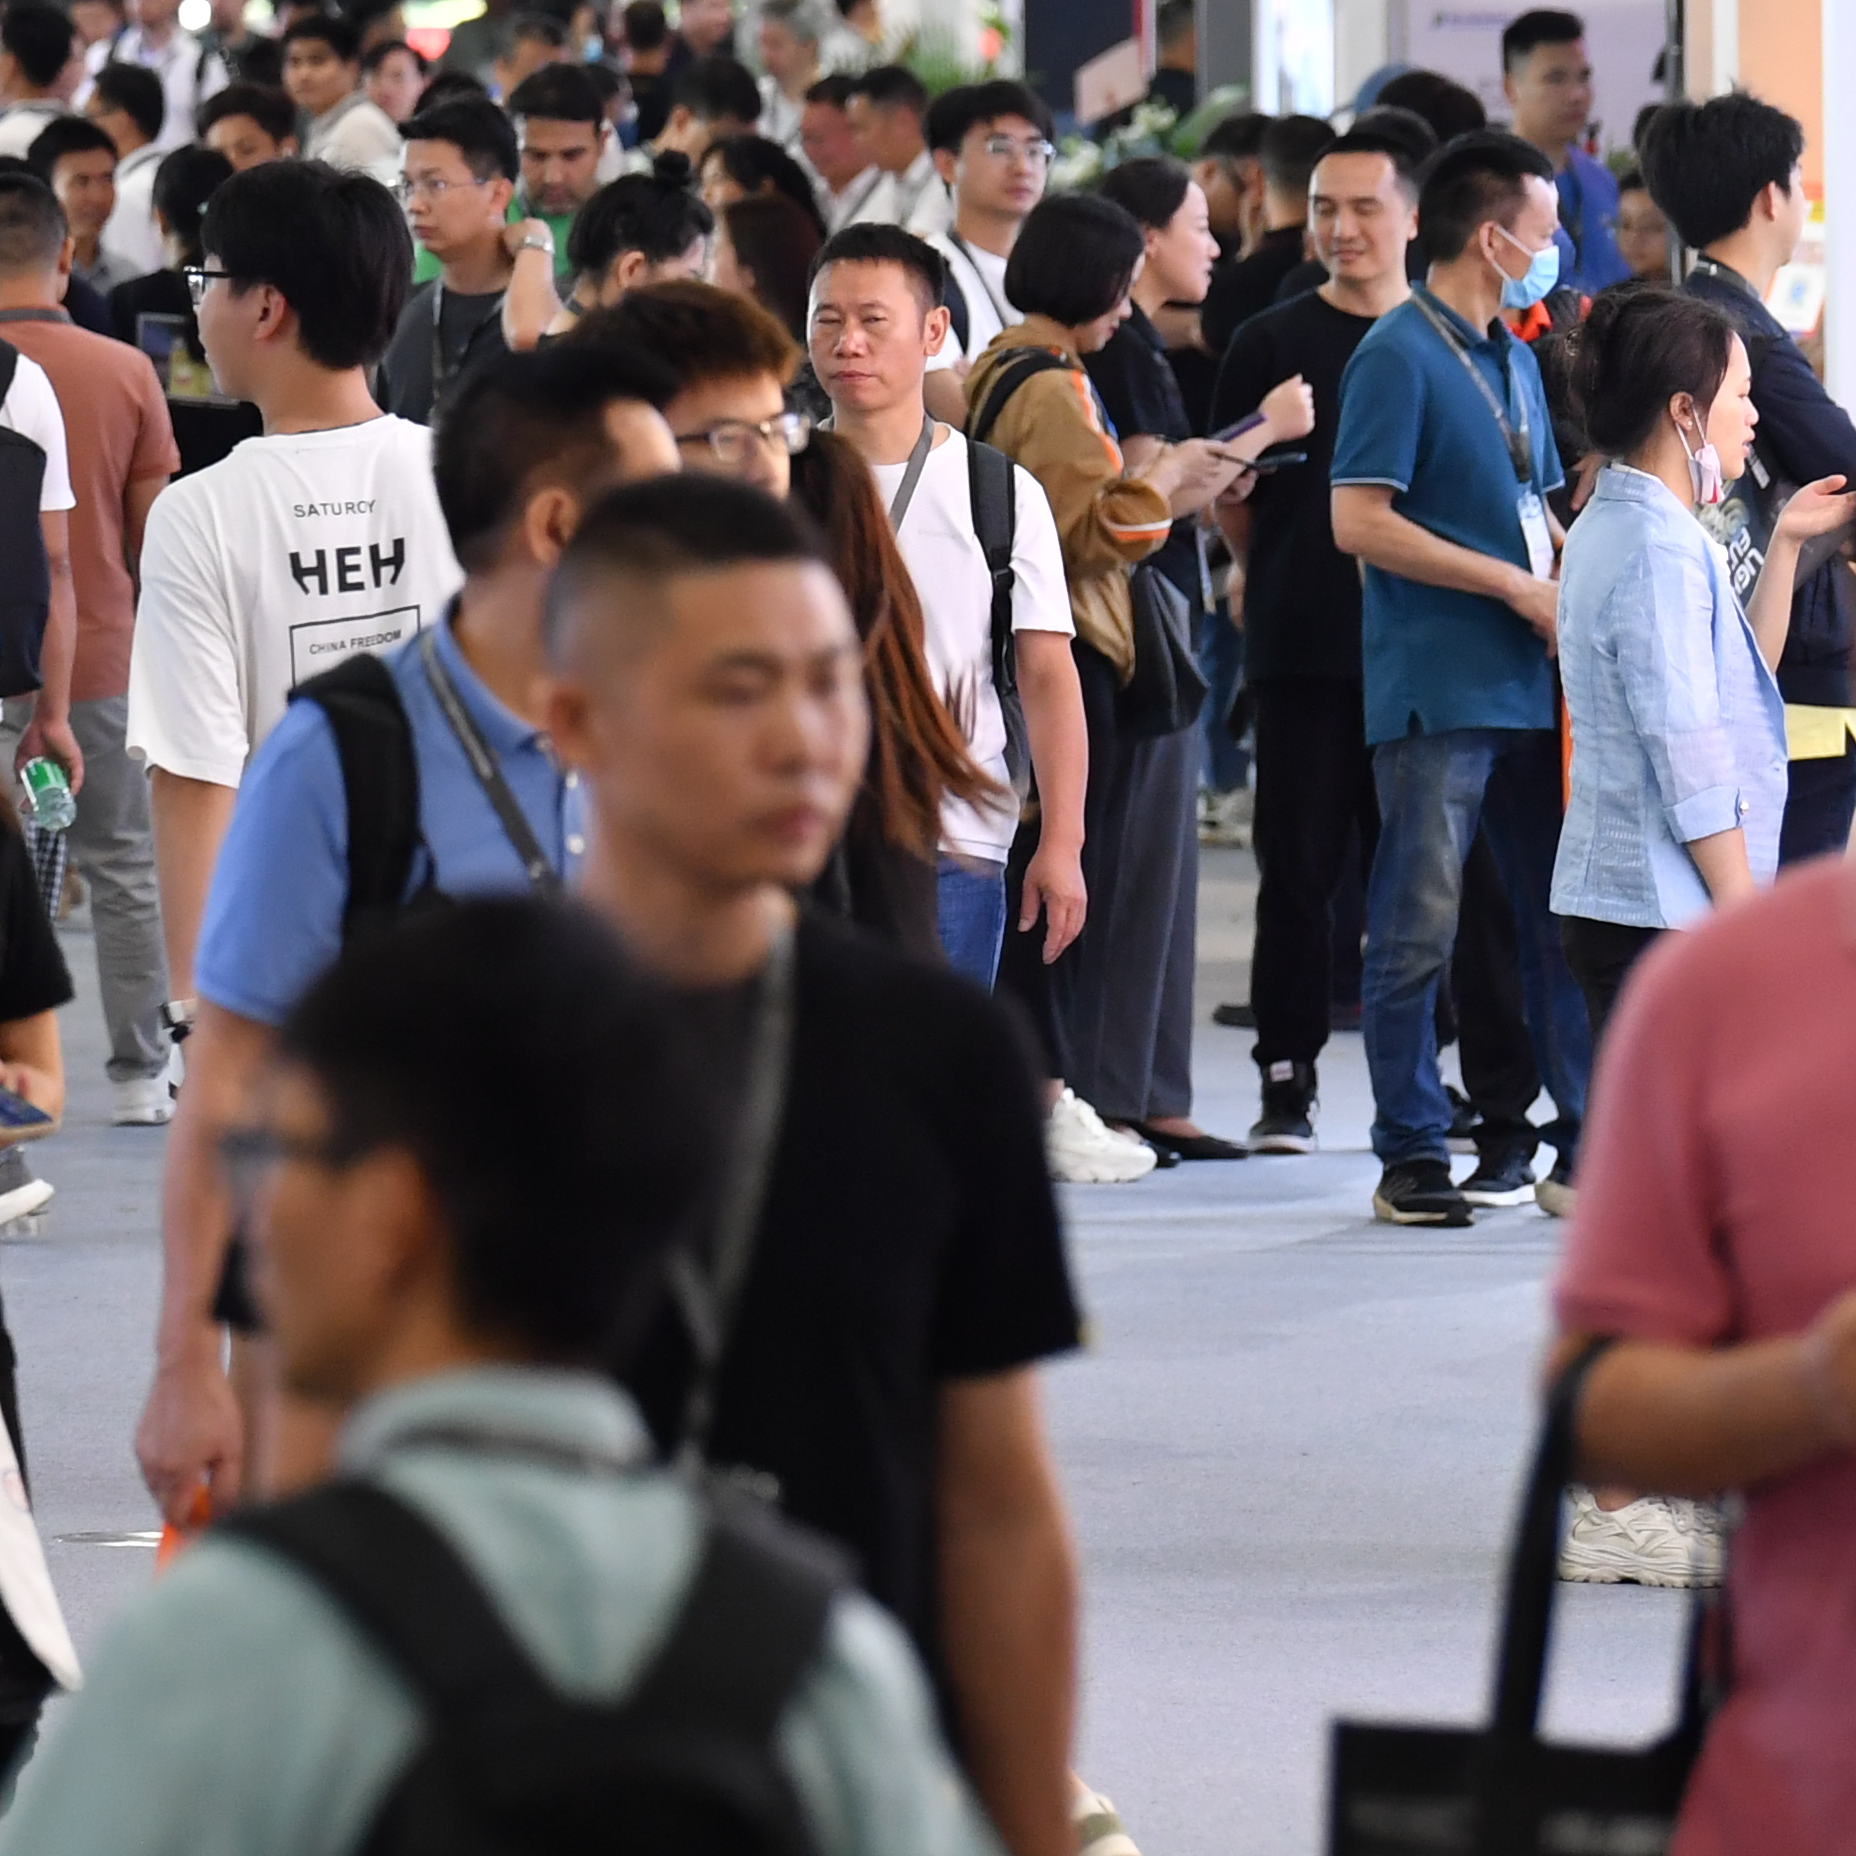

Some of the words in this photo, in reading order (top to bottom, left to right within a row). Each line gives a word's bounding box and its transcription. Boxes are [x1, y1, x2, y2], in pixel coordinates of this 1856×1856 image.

[288, 537, 406, 596] HEH
[308, 639, 347, 656] CHINA
[349, 628, 402, 651] FREEDOM
